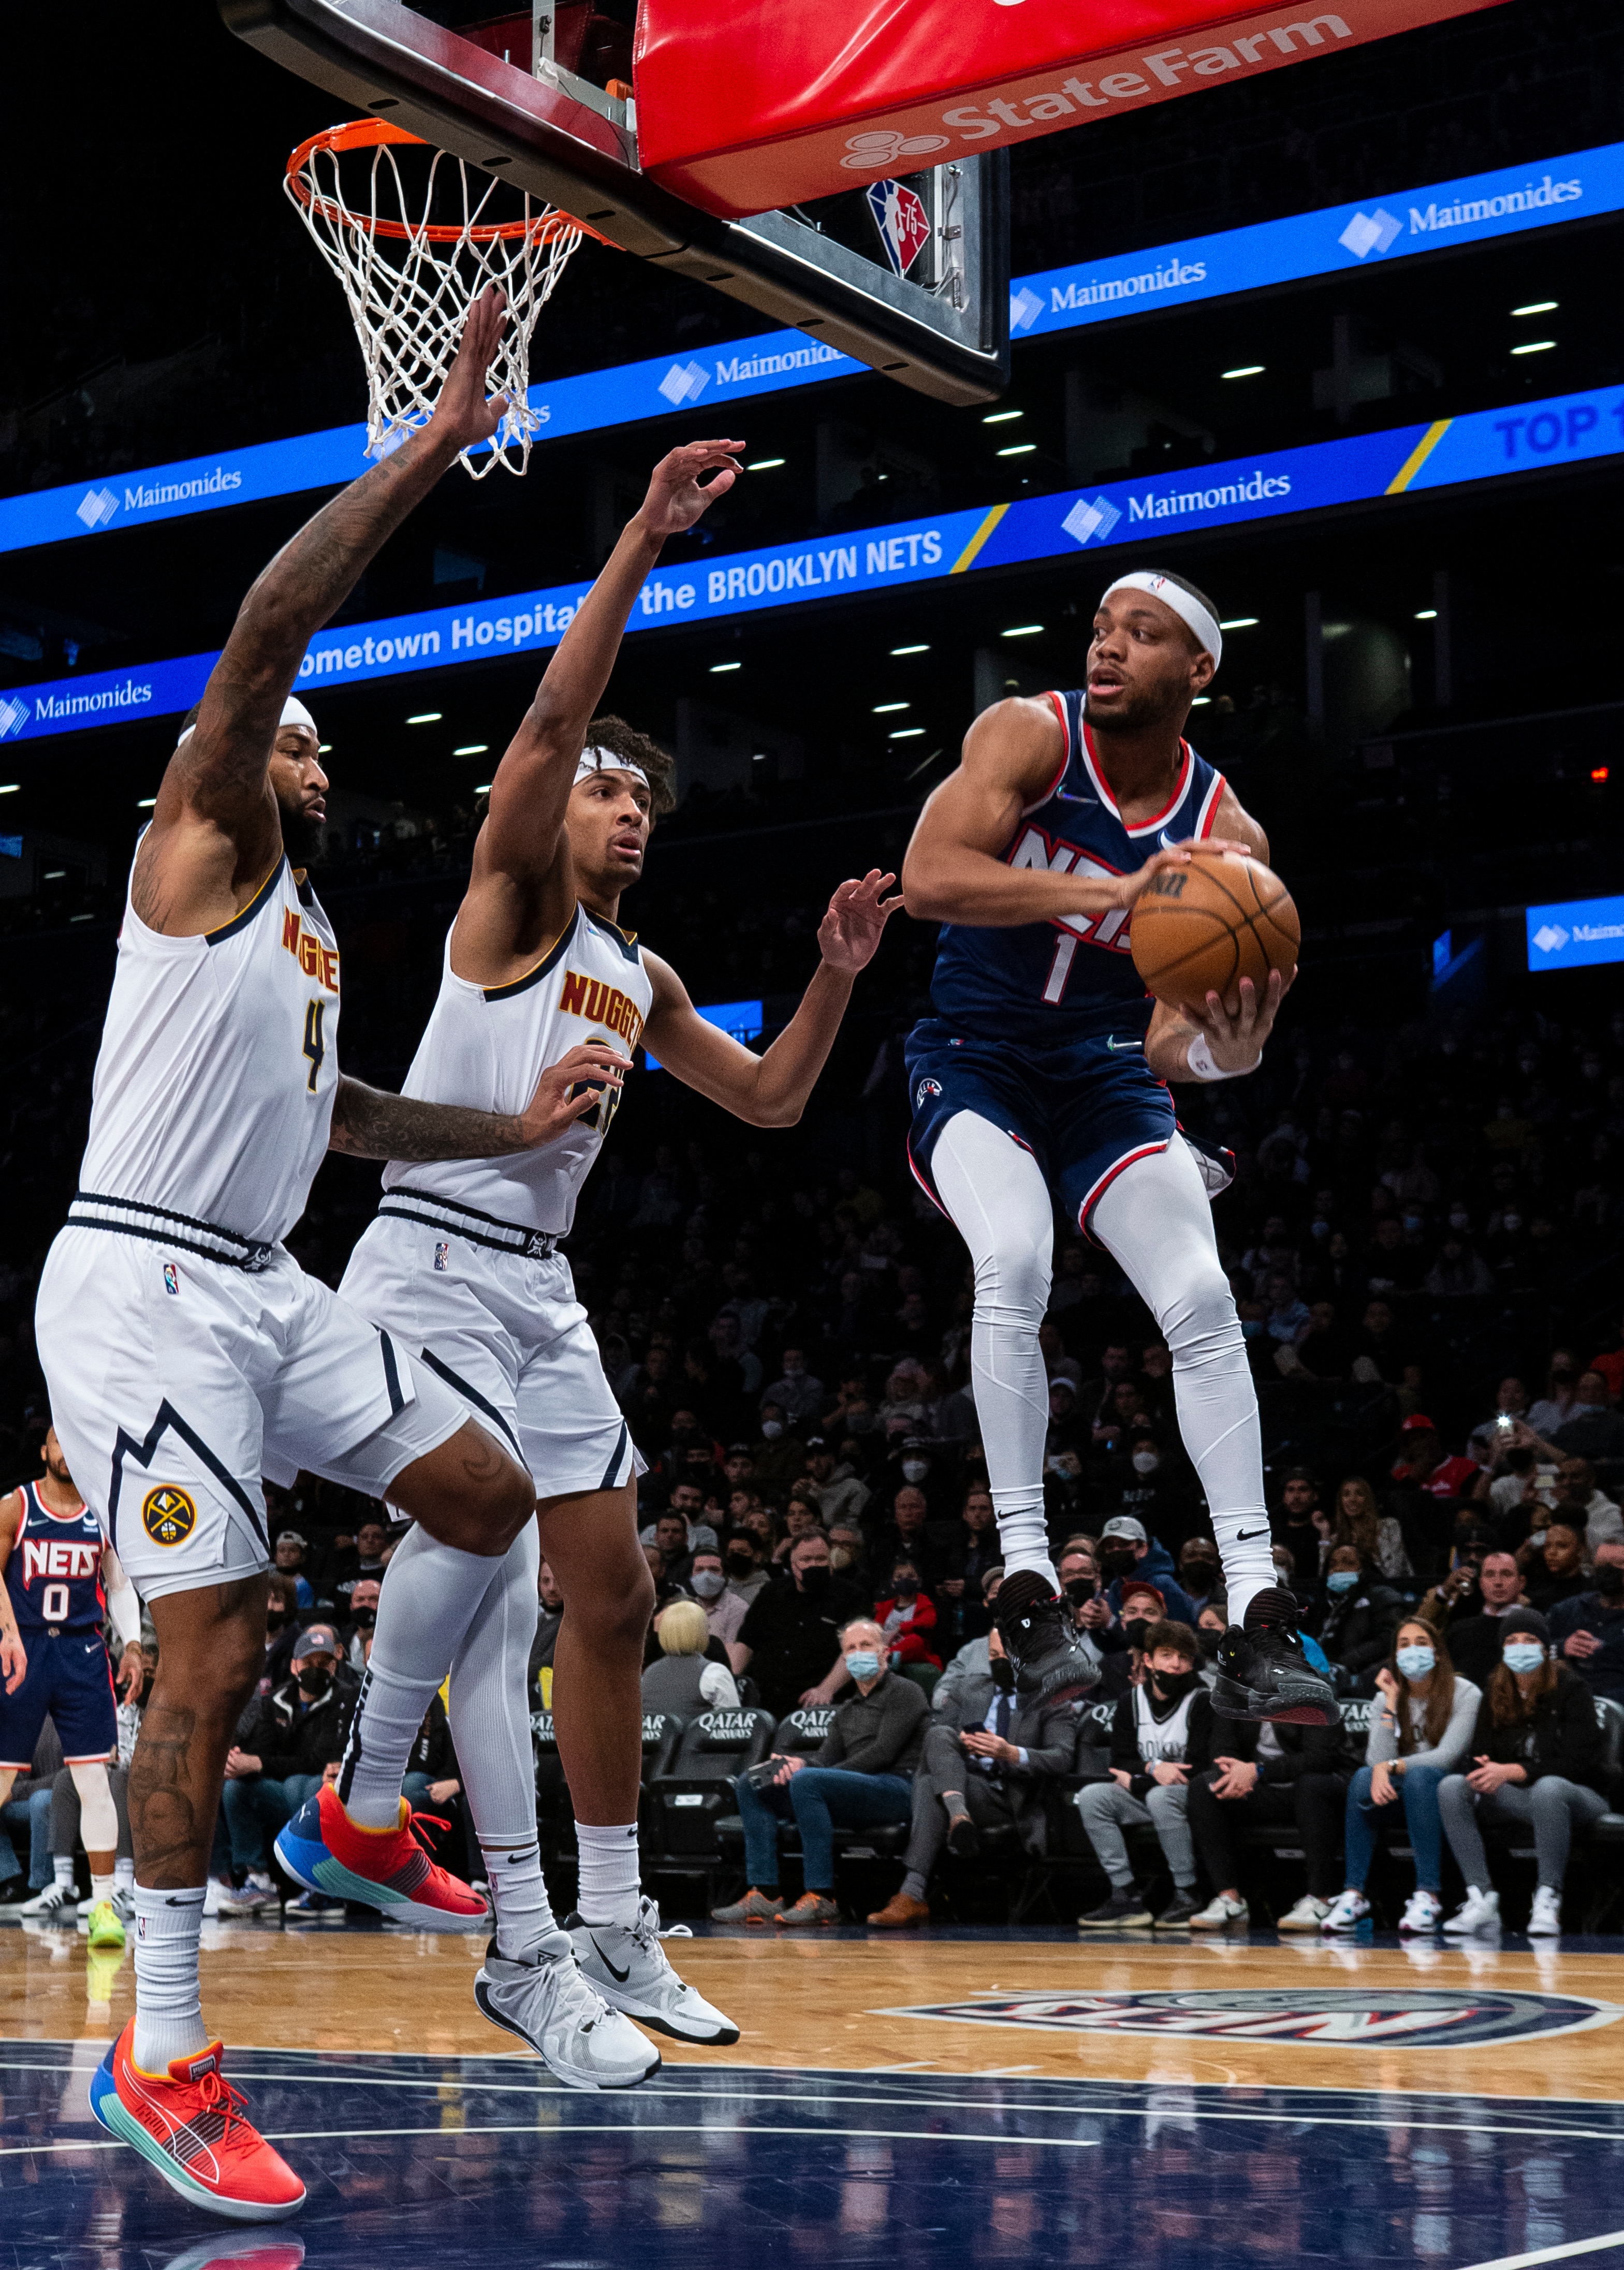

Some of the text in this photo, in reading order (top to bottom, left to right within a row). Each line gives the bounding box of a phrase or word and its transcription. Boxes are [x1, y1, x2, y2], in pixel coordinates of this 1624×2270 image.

[905, 202, 917, 235] 75
[1408, 176, 1583, 235] Maimonides
[1050, 258, 1207, 313] Maimonides
[716, 340, 850, 385] Maimonid
[1494, 405, 1599, 459] TOP
[124, 466, 242, 511] Maimonides
[1128, 470, 1292, 523] Maimonides
[298, 630, 441, 678] ometown
[640, 583, 696, 615] the
[708, 546, 858, 604] BROOKLYN
[867, 530, 943, 575] NETS
[35, 679, 152, 721] Maimonides
[1041, 932, 1078, 1006] 1
[302, 998, 325, 1094] 4
[23, 1538, 102, 1591] NETS
[42, 1583, 69, 1622] 0
[699, 1712, 757, 1731] QATAR
